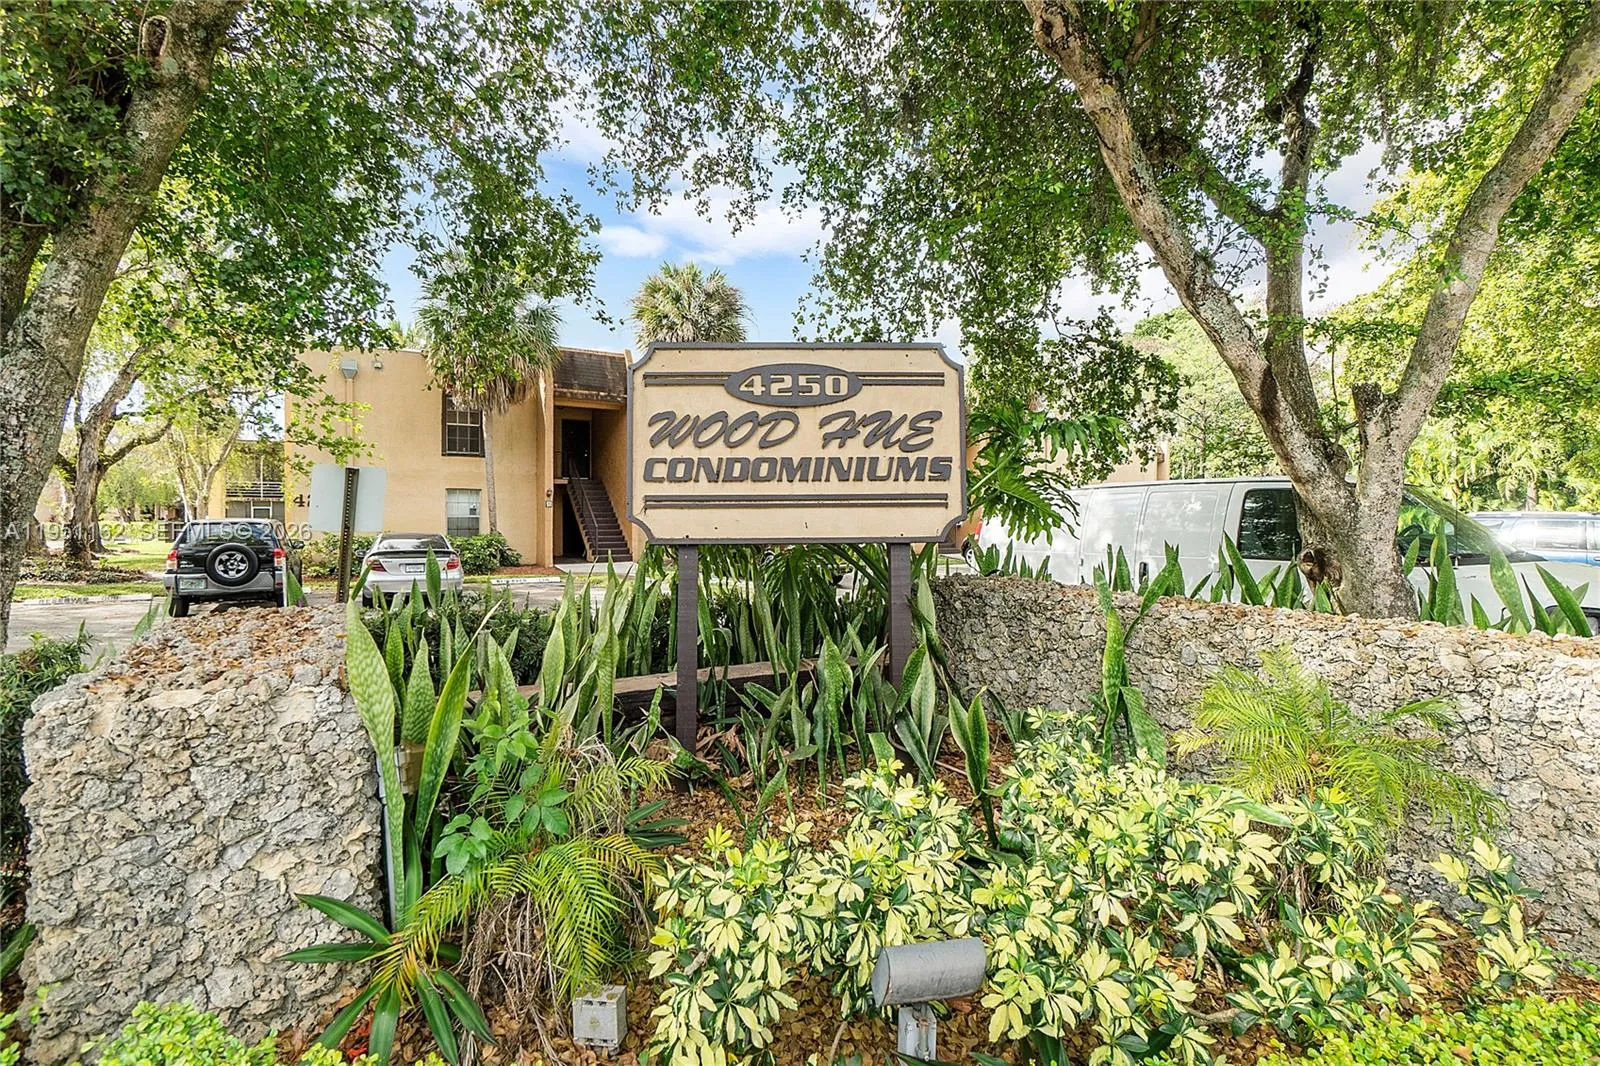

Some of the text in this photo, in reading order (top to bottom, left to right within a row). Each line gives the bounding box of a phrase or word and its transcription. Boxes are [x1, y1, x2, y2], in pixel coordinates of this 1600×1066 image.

[738, 374, 849, 397] 4250
[648, 410, 943, 453] WOOD HUE
[643, 456, 953, 483] CONDOMINIUMS
